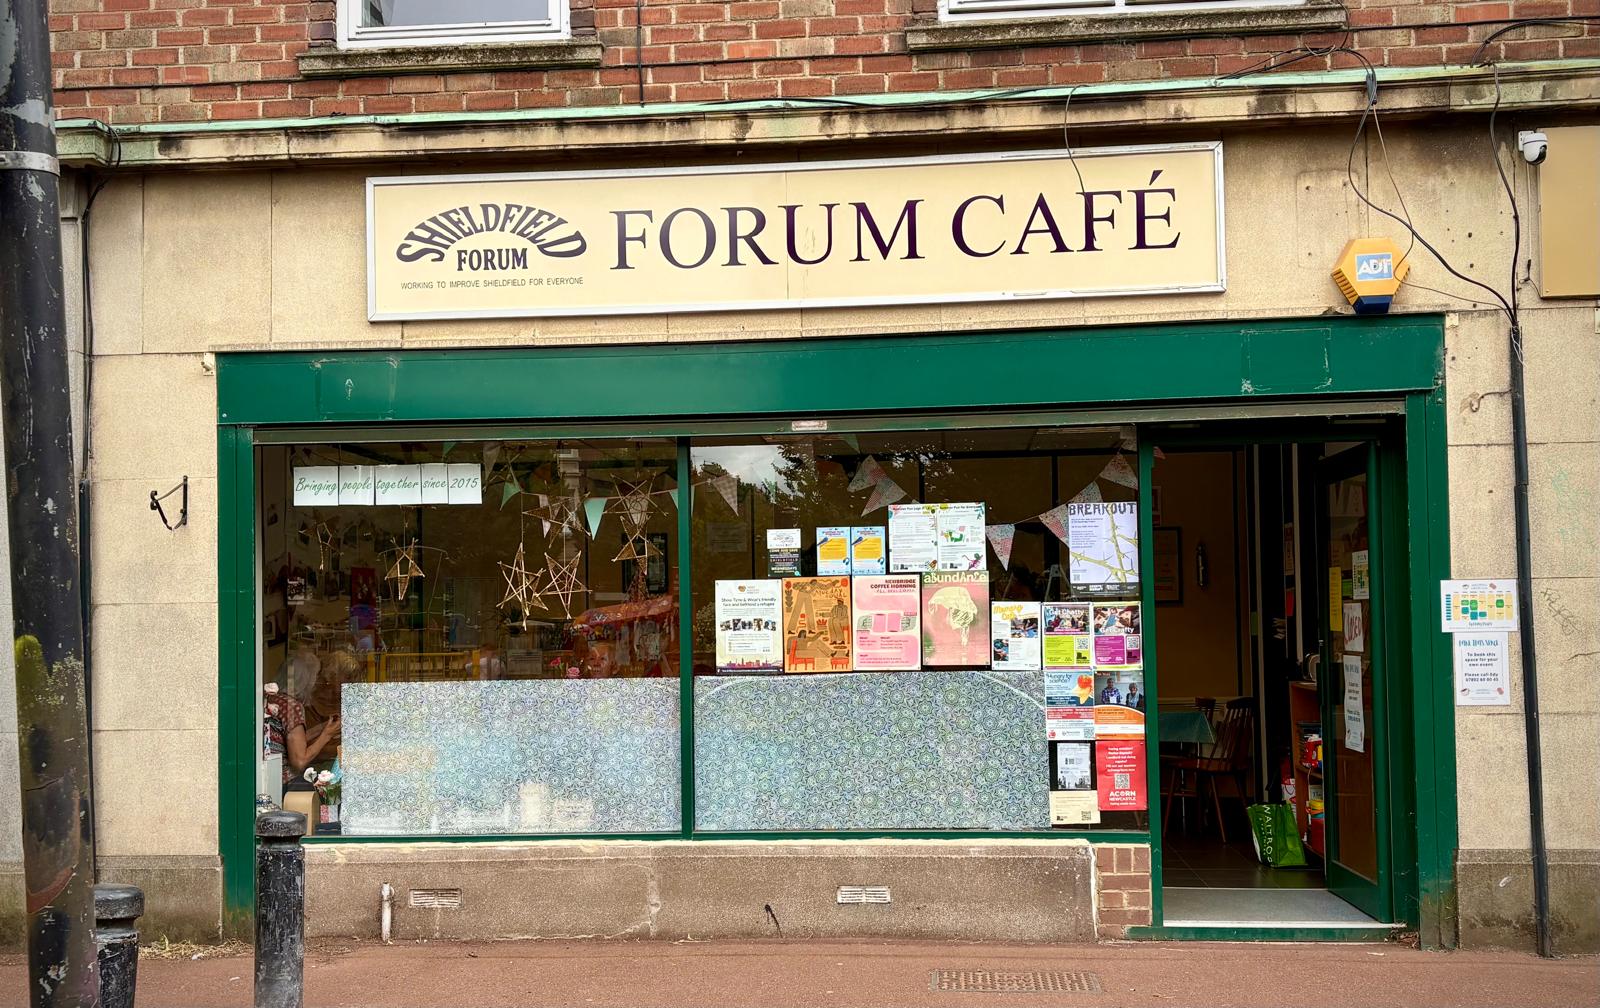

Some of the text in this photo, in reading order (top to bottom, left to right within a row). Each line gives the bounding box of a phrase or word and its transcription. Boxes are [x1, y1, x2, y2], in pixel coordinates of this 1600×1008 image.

[609, 169, 1181, 270] FORUM CAFÉ
[396, 203, 587, 263] SHIELDFIELD
[456, 247, 529, 272] FORUM
[1358, 258, 1391, 275] ADT
[400, 276, 584, 290] WORKING TO IMPROVE SHIELDFIELD FOR EVERYONE
[295, 476, 479, 496] Bringing people together since 2015
[1069, 503, 1137, 517] BREAKOUT
